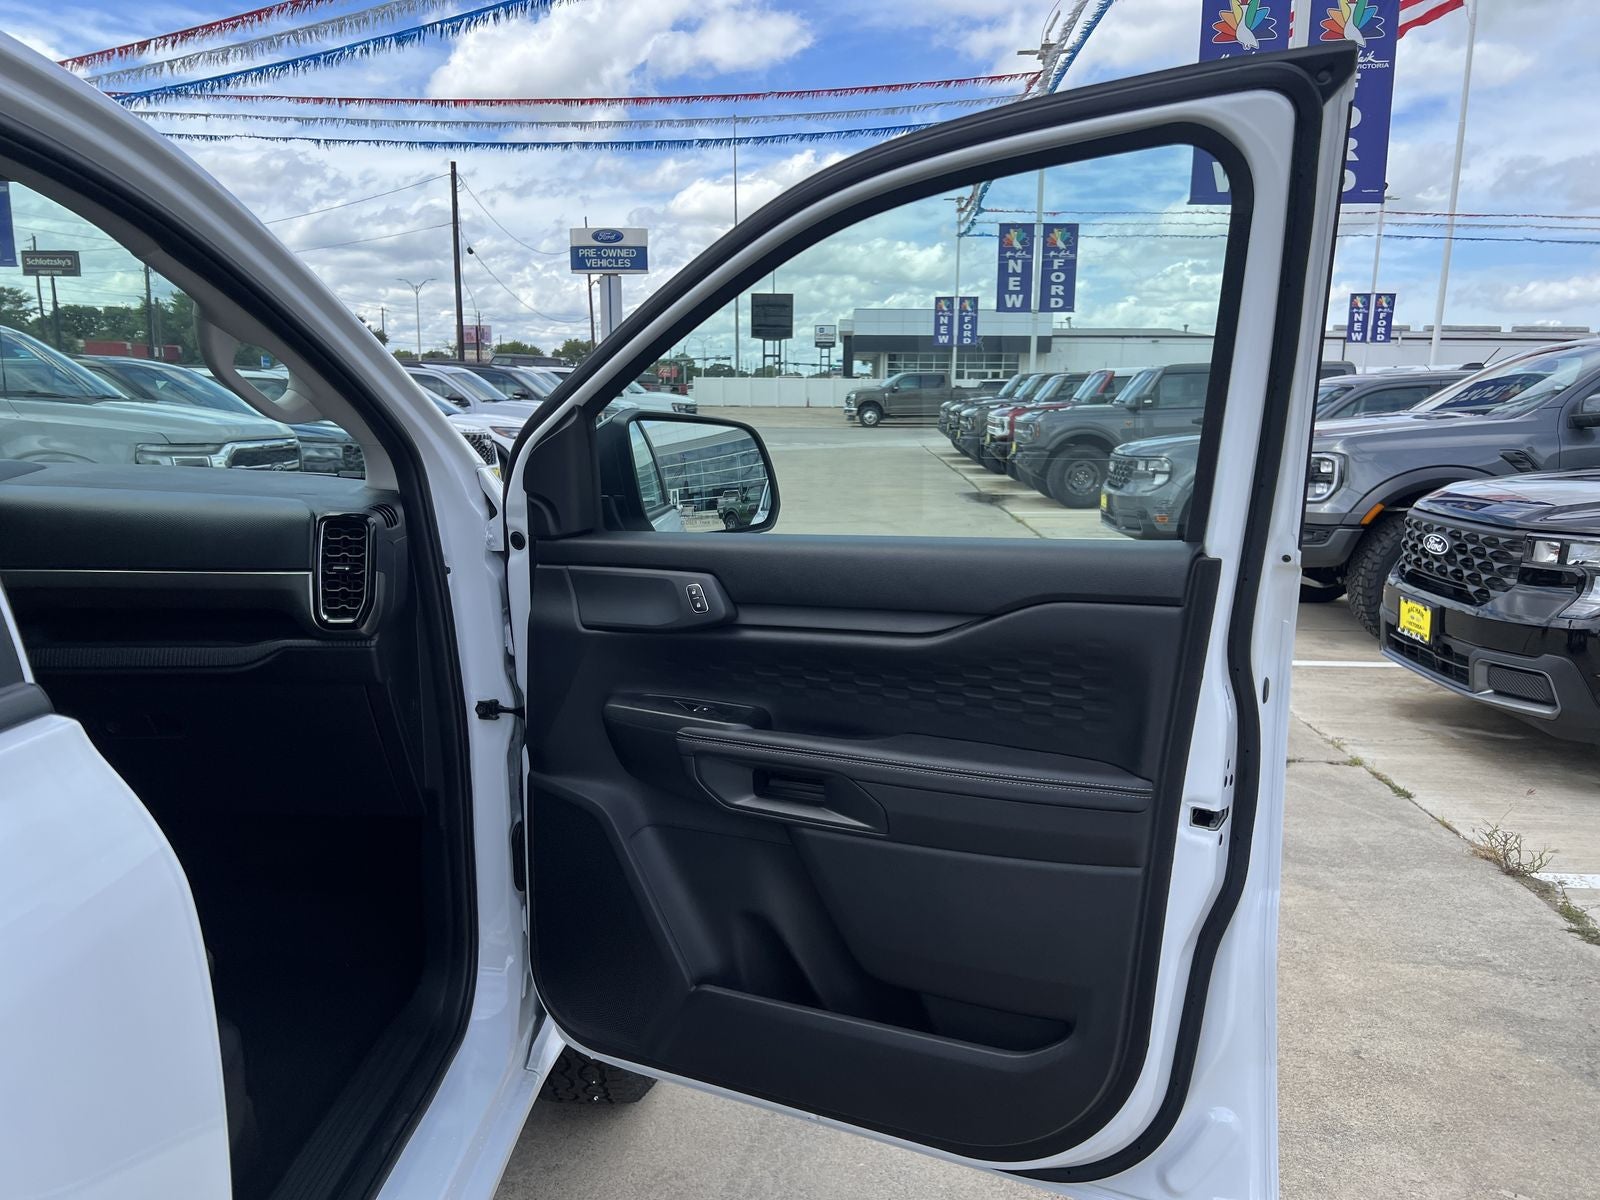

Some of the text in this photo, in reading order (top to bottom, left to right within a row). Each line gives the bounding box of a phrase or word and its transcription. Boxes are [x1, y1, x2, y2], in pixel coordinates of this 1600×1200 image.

[597, 232, 616, 241] Ford
[26, 257, 72, 267] Schlotzsky's
[585, 259, 631, 267] VEHICLES
[1004, 259, 1024, 308] NEW
[1050, 259, 1066, 308] FORD
[938, 316, 949, 344] NEW
[963, 316, 972, 344] FORD
[1351, 313, 1363, 341] NEW
[1376, 313, 1387, 341] FORD
